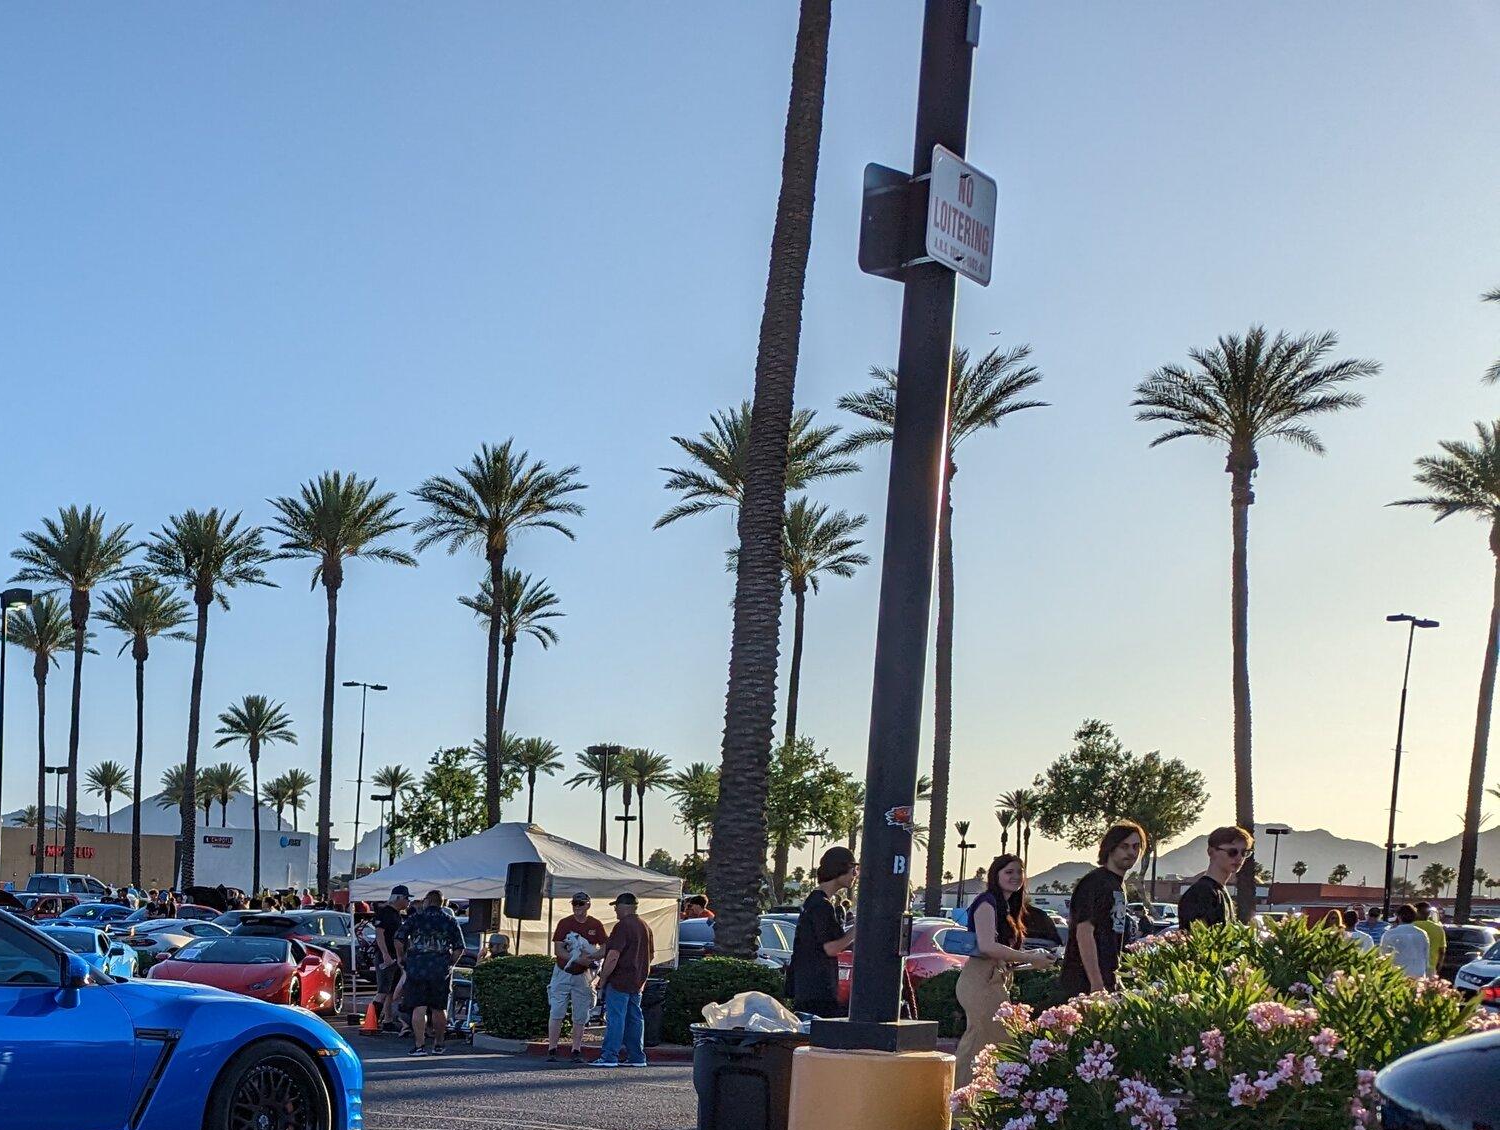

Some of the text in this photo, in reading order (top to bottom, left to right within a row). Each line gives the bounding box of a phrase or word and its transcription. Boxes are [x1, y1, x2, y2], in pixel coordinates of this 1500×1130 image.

[958, 172, 973, 208] NO
[934, 196, 990, 256] LOITERING
[75, 847, 96, 858] LUS
[893, 855, 906, 874] B
